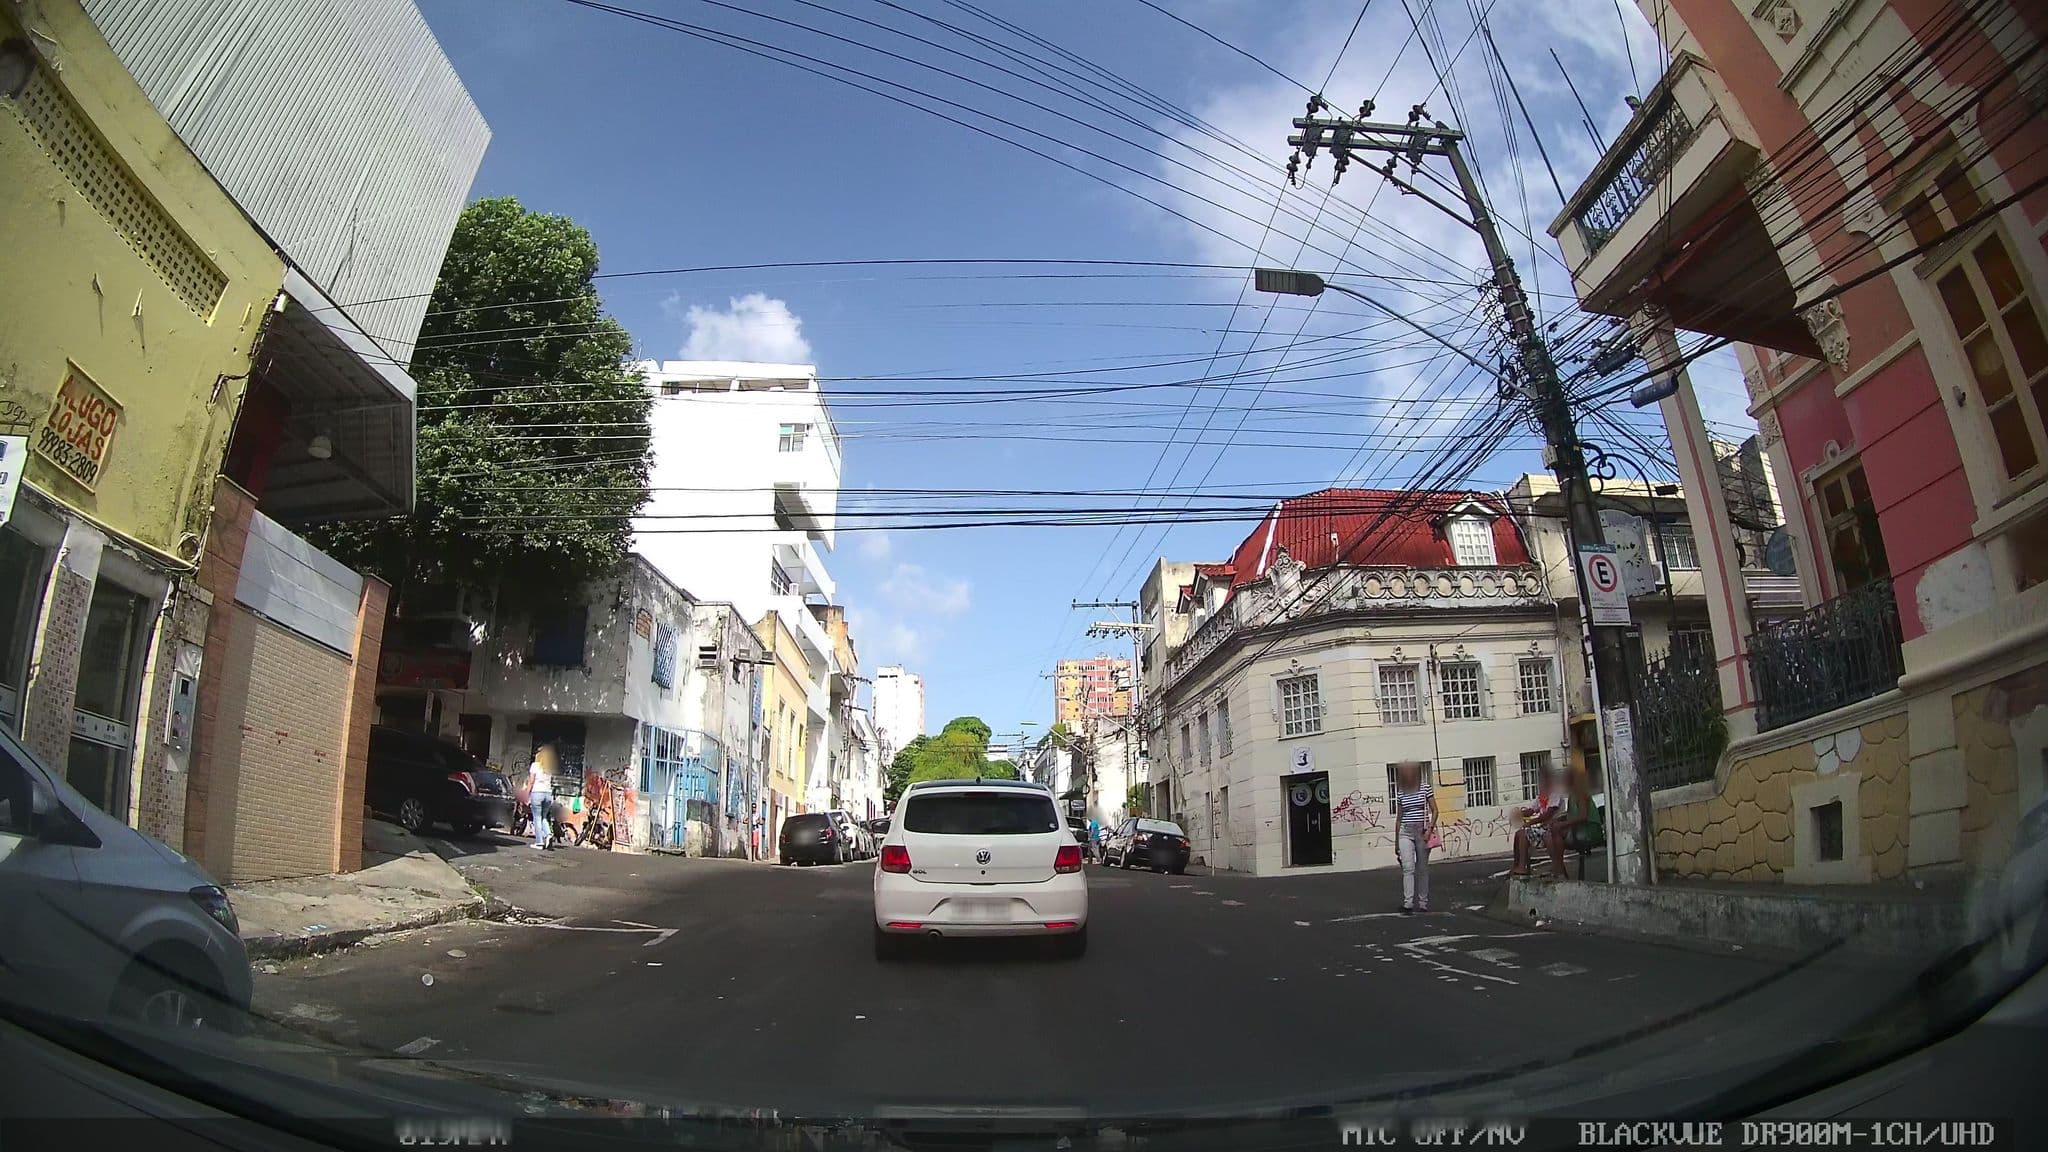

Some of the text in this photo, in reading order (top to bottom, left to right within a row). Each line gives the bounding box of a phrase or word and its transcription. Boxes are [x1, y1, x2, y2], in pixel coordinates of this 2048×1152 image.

[47, 402, 105, 461] LOJAS
[56, 374, 118, 437] ALUGO
[37, 426, 98, 484] 99983-2809
[1595, 561, 1611, 585] E
